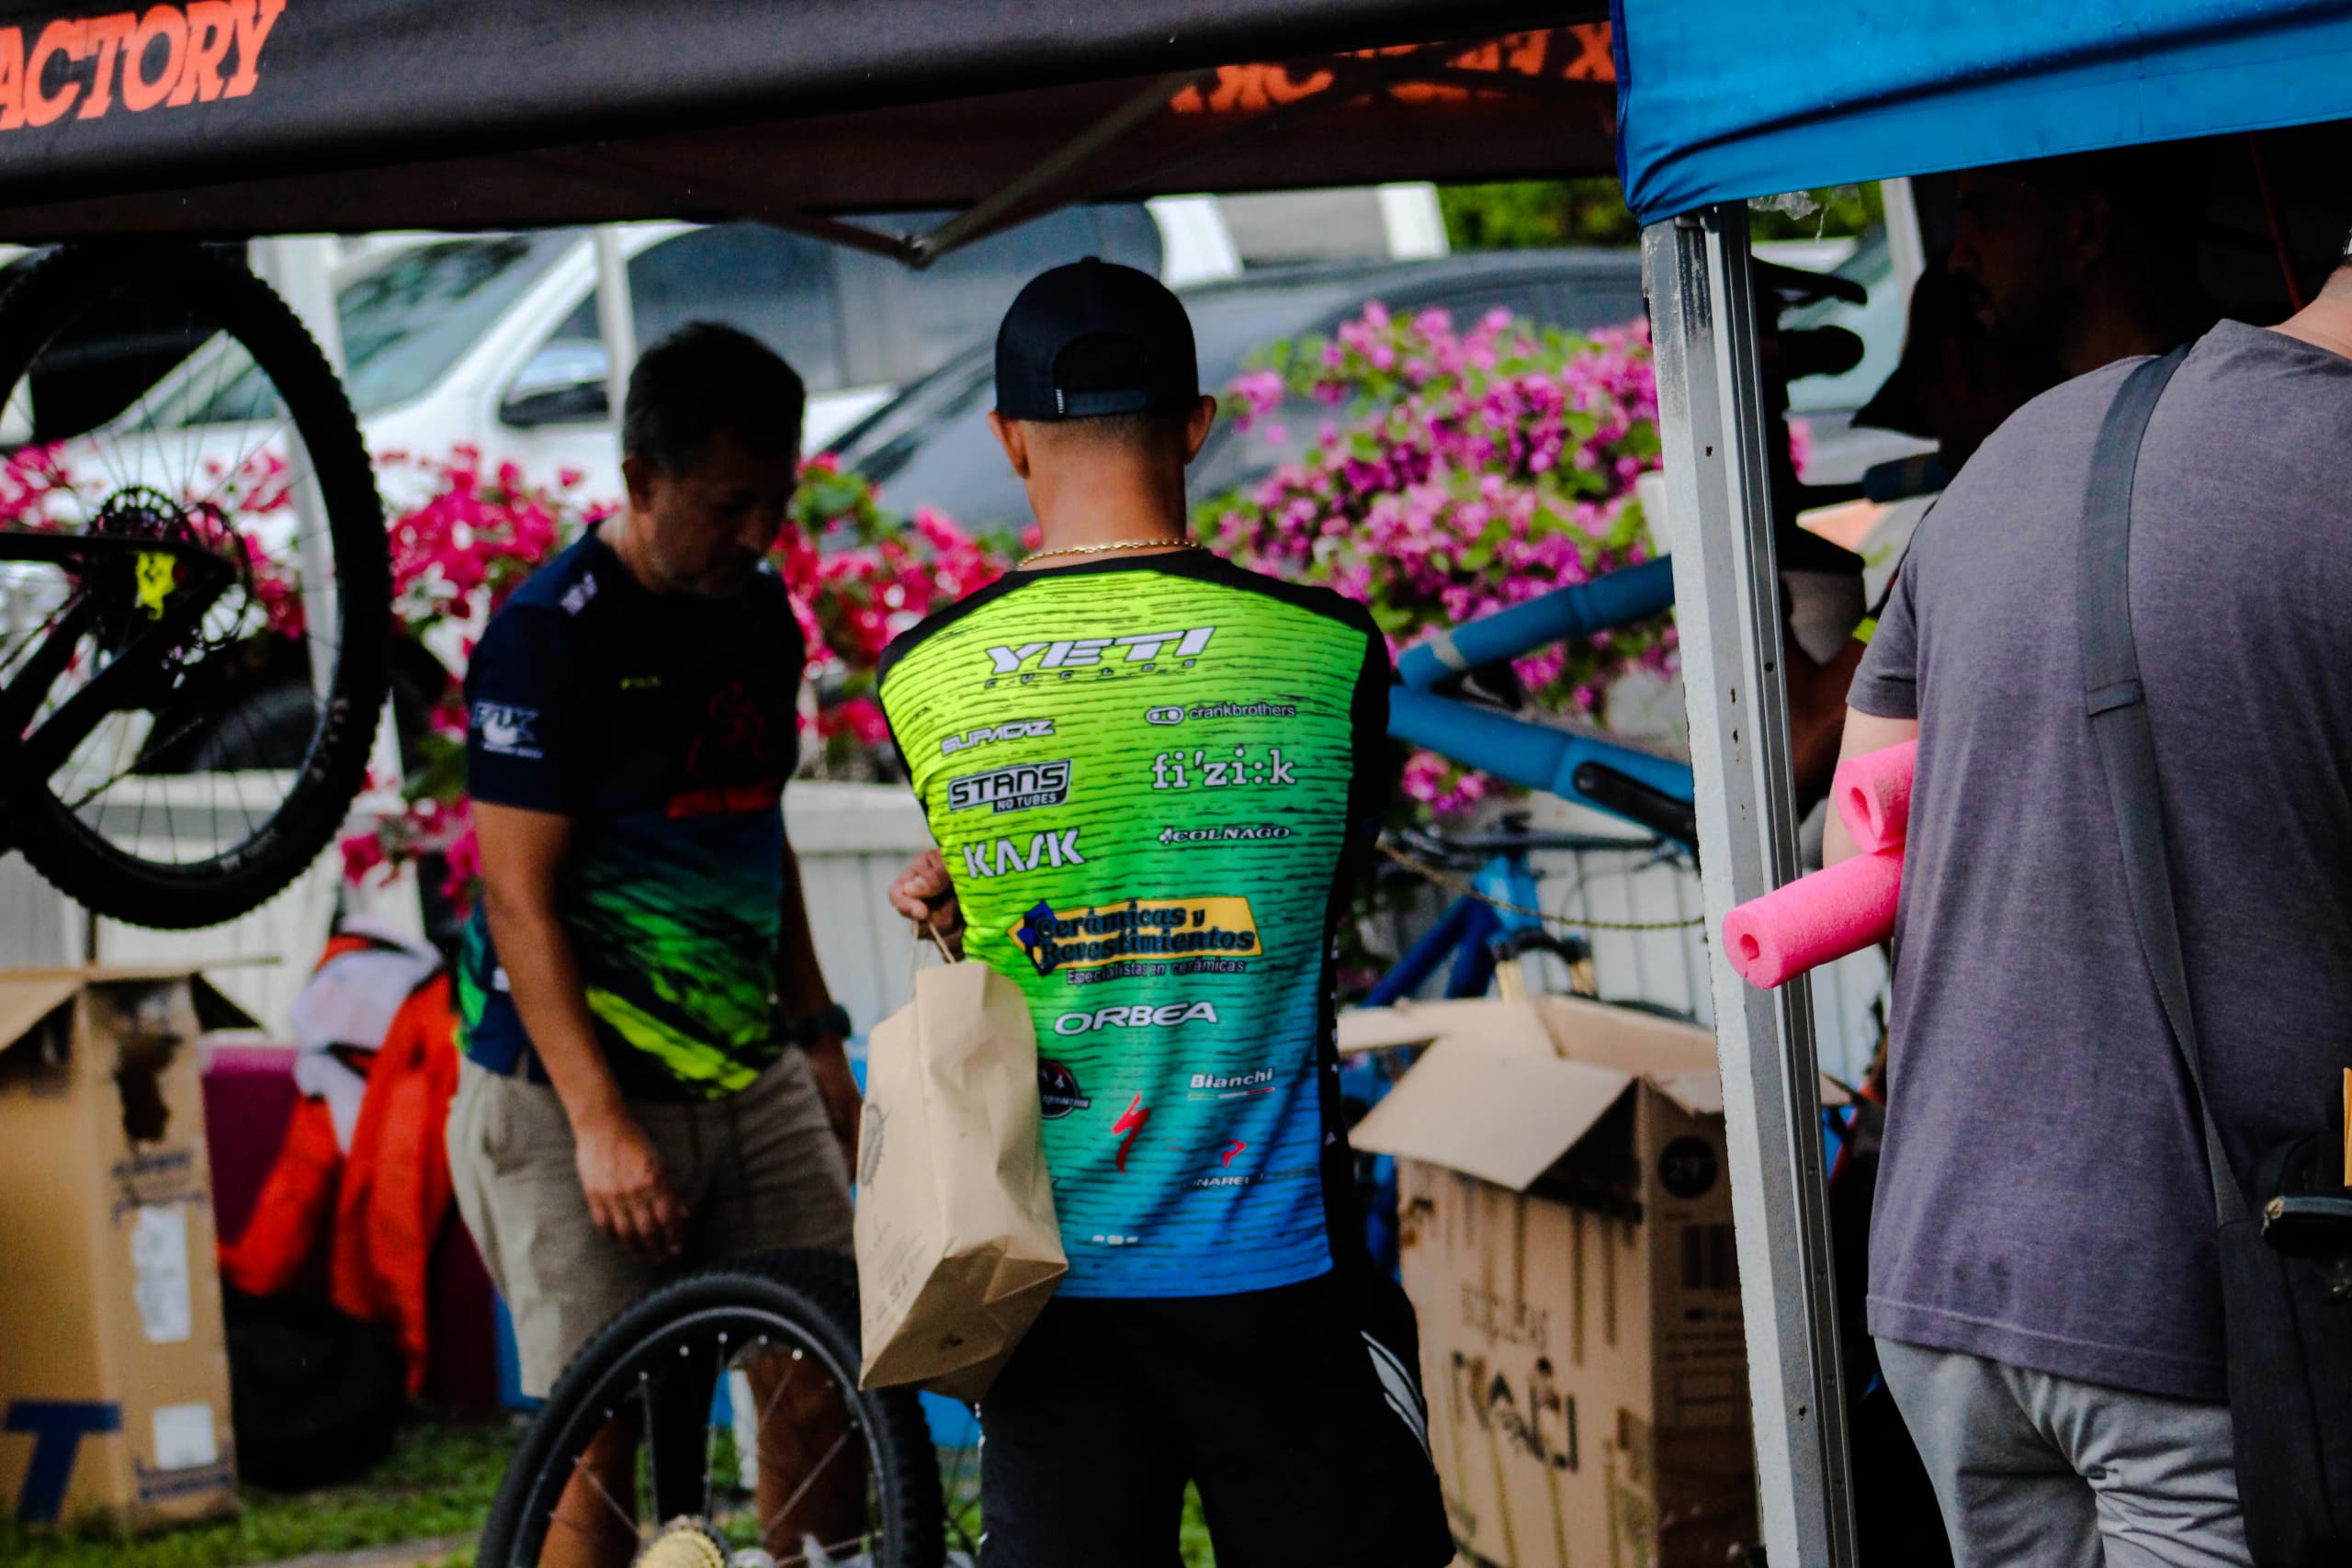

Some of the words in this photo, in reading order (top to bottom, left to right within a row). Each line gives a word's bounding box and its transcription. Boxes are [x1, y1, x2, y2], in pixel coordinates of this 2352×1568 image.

[986, 626, 1216, 675] YETI
[1190, 702, 1296, 719] crankbrothers
[996, 799, 1014, 811] NO
[1016, 793, 1057, 808] TUBES
[1172, 827, 1291, 842] COLNAGO
[963, 829, 1085, 879] KASK
[1040, 927, 1256, 965] Revestimientos
[1054, 1001, 1218, 1035] ORBEA
[1189, 1068, 1273, 1089] Bianchi
